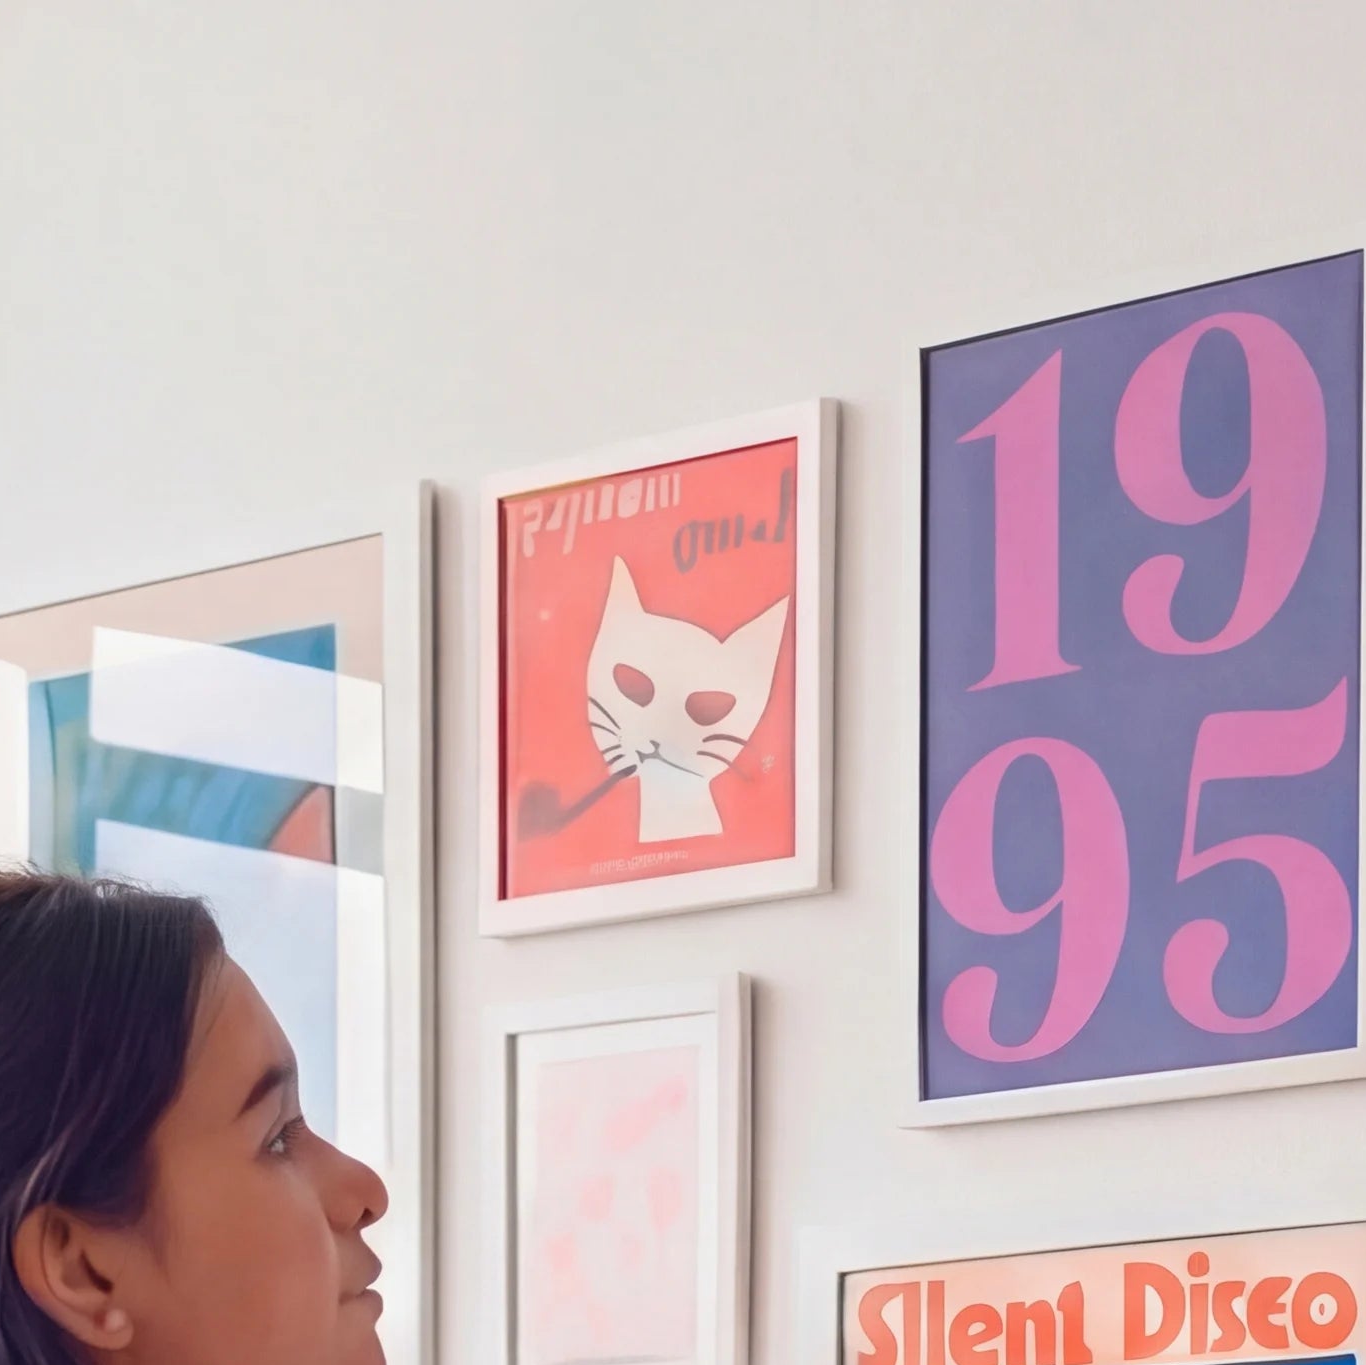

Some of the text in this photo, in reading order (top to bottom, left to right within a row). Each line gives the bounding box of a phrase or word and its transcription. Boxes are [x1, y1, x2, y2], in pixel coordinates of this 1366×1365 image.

[955, 311, 1328, 693] 19
[929, 676, 1354, 1063] 95
[1123, 1251, 1359, 1361] Disco
